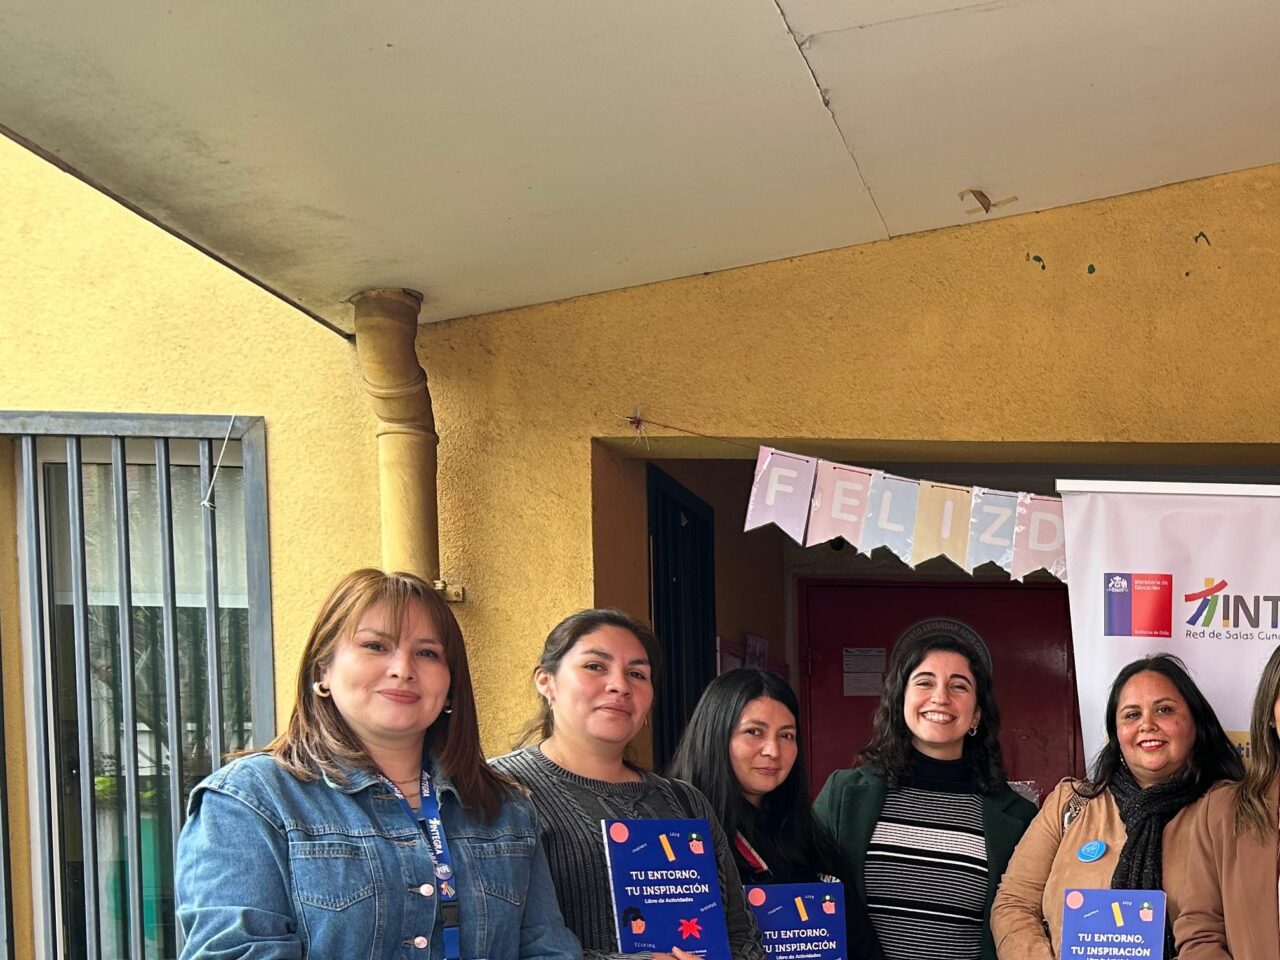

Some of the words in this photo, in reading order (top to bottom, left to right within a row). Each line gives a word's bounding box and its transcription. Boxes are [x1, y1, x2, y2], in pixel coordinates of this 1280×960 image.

[765, 466, 1012, 546] FELIZ
[1185, 629, 1205, 639] Red
[1208, 630, 1222, 639] de
[1225, 630, 1254, 640] Salas
[630, 871, 644, 880] TU
[648, 870, 700, 880] ENTORNO,
[625, 886, 640, 896] TU
[643, 882, 709, 895] INSPIRACIÓN
[764, 931, 778, 940] TU
[781, 928, 830, 939] ENTORNO,
[1078, 933, 1092, 942] TU
[1094, 933, 1144, 944] ENTORNO,
[775, 940, 837, 953] INSPIRACIÓN
[1071, 946, 1084, 955] TU
[1087, 946, 1151, 957] INSPIRACIÓN
